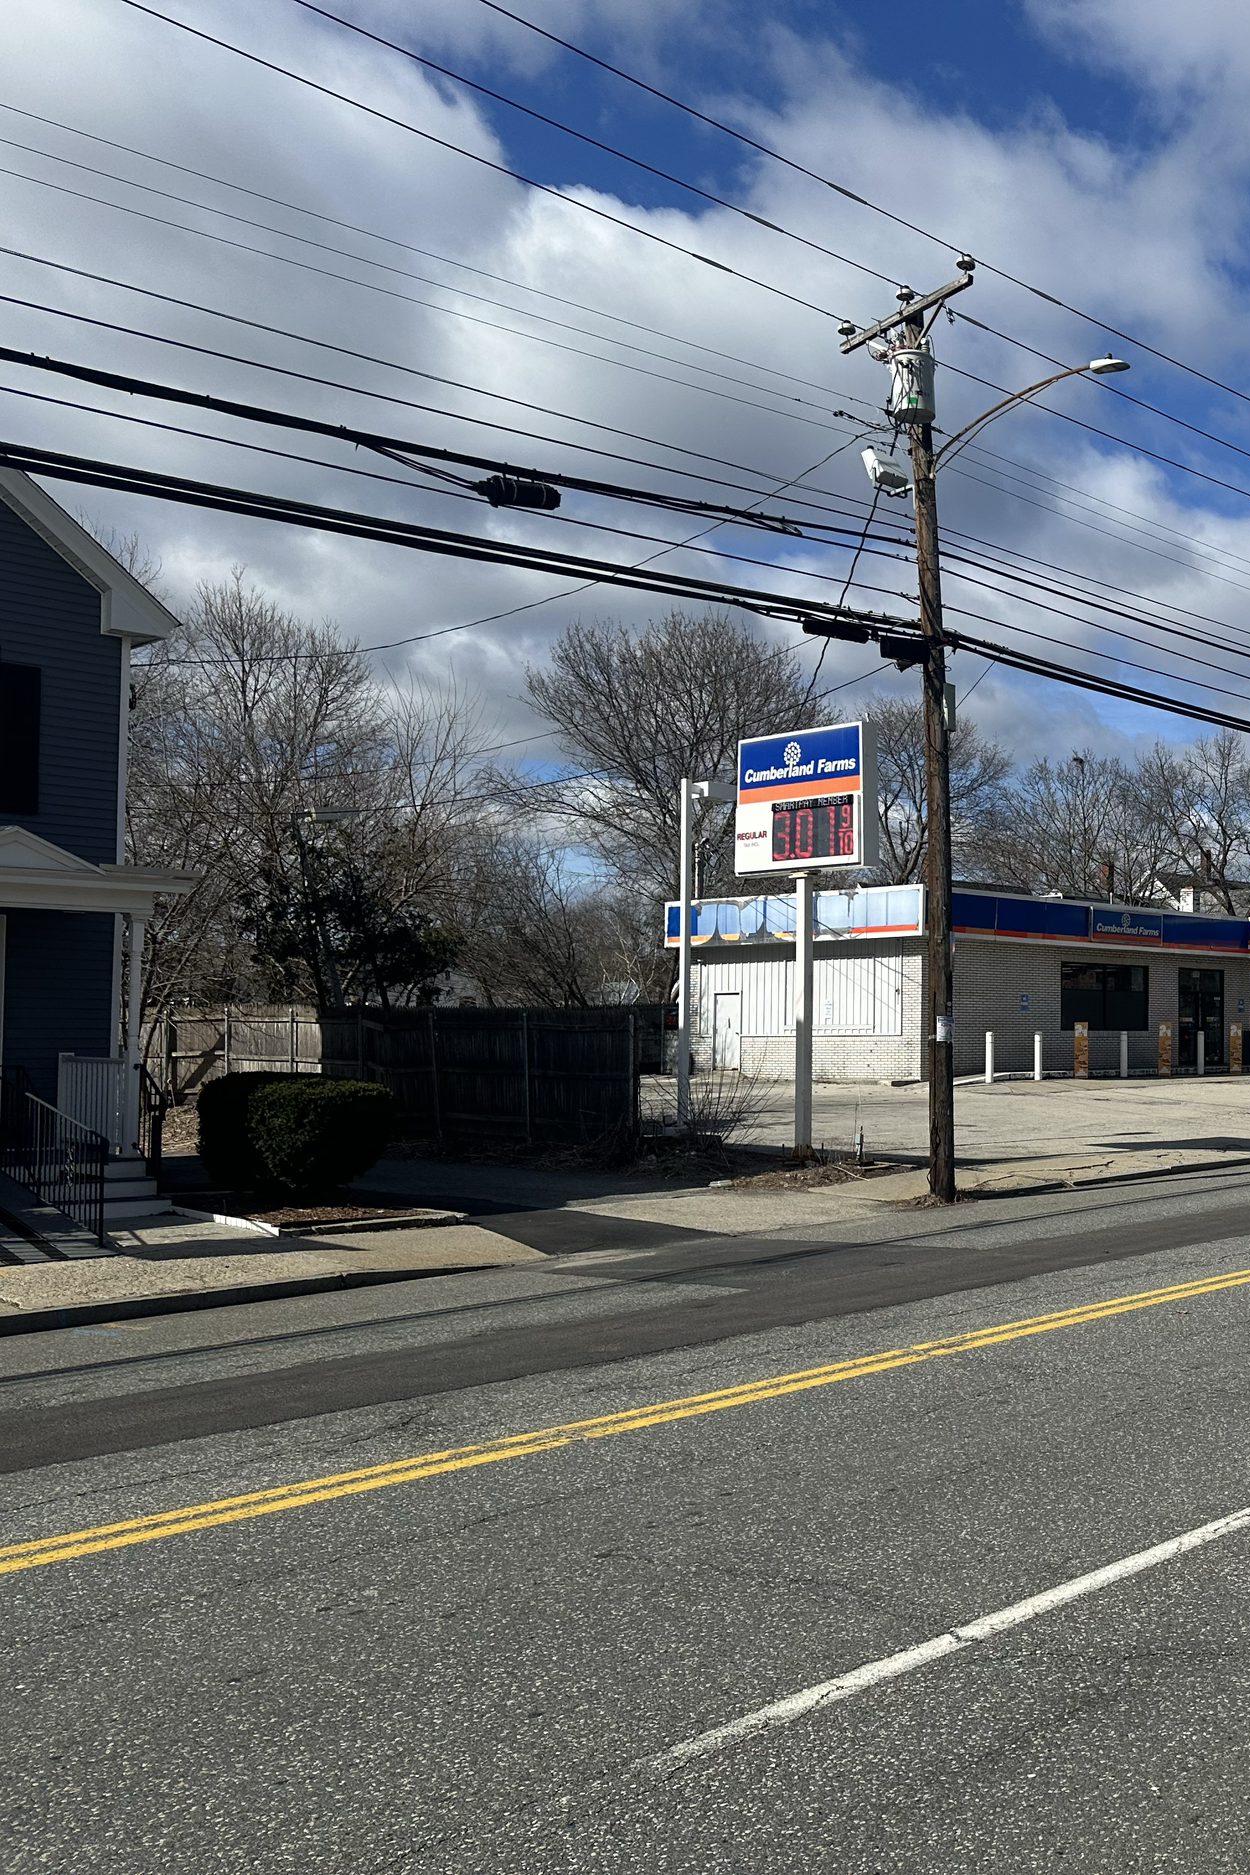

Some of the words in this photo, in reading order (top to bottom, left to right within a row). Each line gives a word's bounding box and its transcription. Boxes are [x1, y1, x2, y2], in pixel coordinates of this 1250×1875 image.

[744, 761, 815, 783] Cumberland
[817, 757, 856, 773] Farms
[775, 799, 813, 811] SMARTPAY
[817, 795, 848, 806] MEMBER
[736, 830, 768, 841] REGULAR
[1096, 922, 1139, 935] Cumberland
[1138, 926, 1160, 937] Farms
